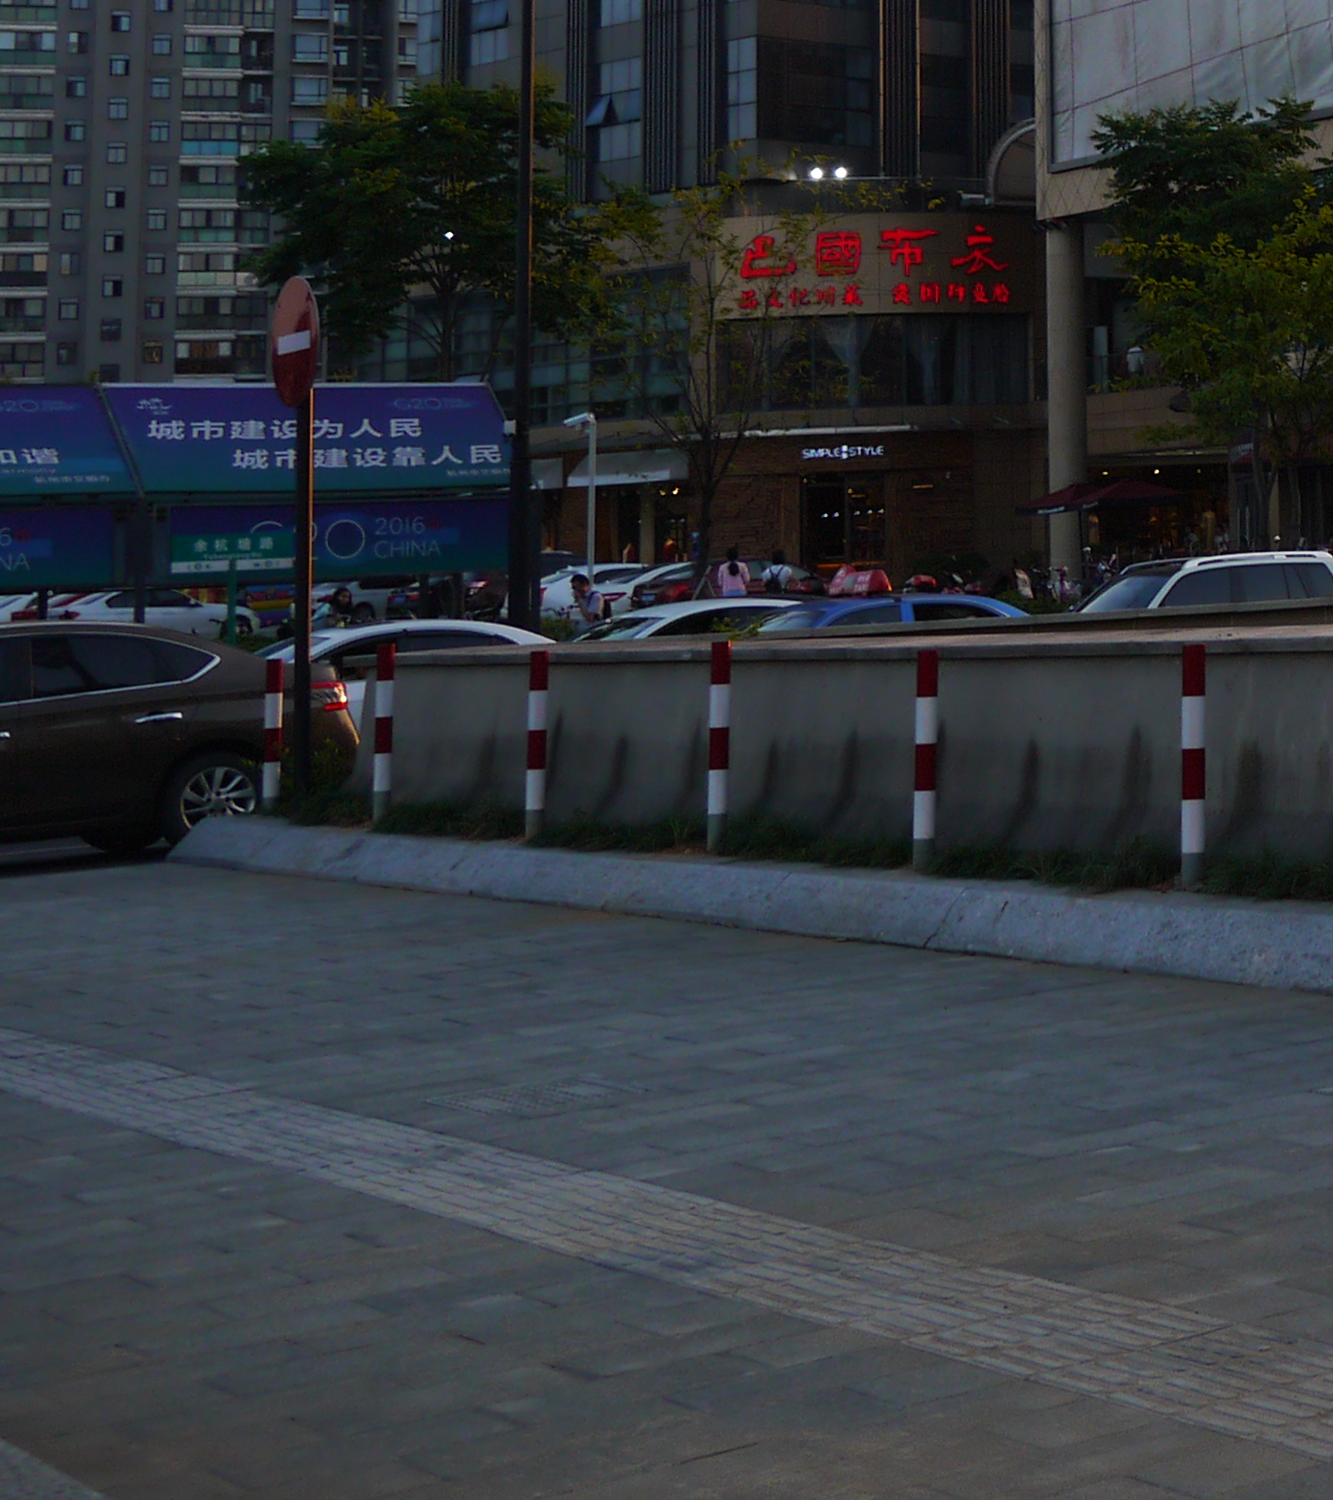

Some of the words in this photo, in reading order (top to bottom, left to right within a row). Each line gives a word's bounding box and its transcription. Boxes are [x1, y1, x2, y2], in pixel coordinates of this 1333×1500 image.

[147, 417, 423, 441] 城市建设为人民
[231, 444, 502, 470] 城市建设靠人民
[374, 516, 426, 536] 2016
[373, 539, 442, 559] CHINA
